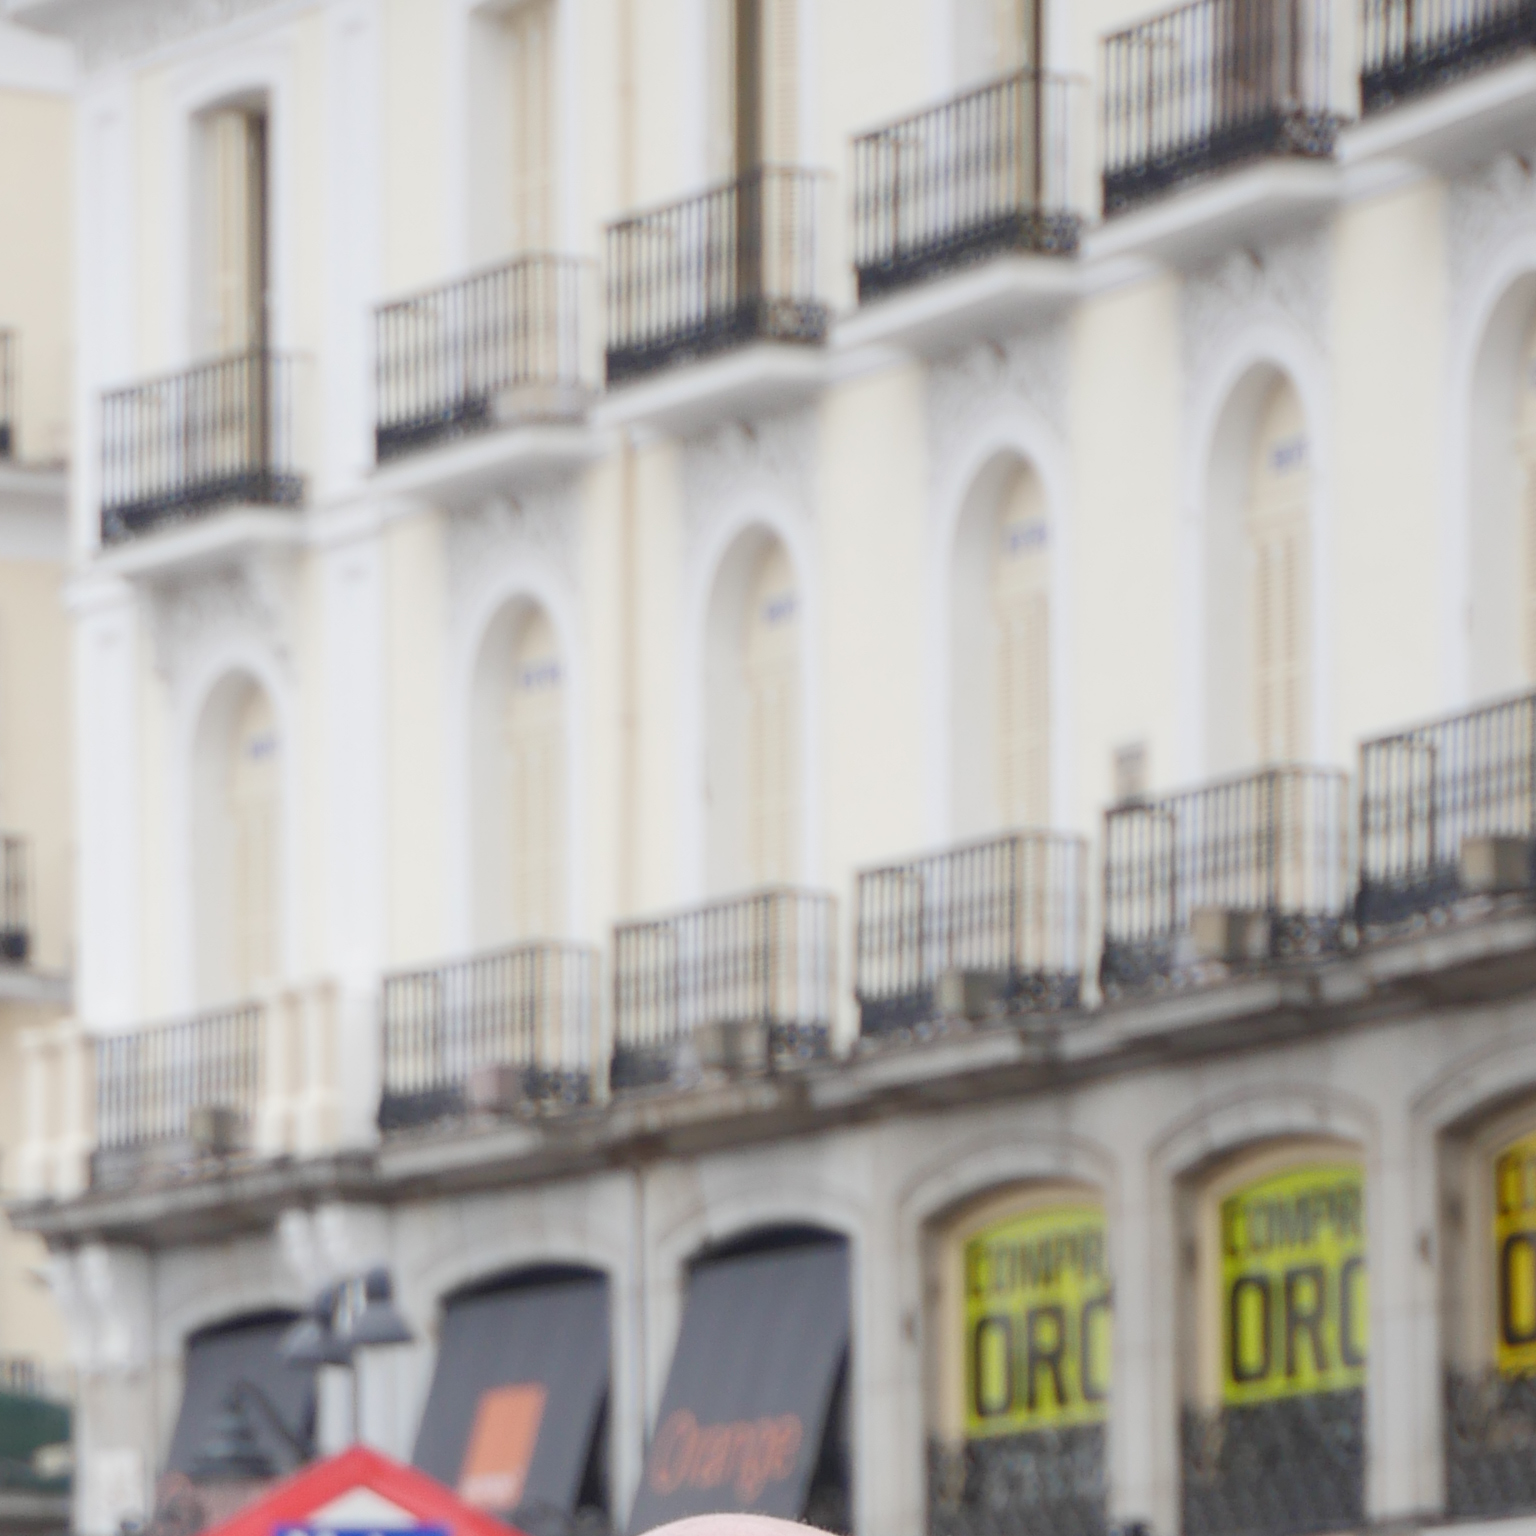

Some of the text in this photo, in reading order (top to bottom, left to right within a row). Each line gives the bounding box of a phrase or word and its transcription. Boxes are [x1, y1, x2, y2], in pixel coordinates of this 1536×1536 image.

[1221, 1183, 1362, 1256] COMPR
[966, 1227, 1105, 1297] COMPR
[649, 1407, 803, 1504] Orange
